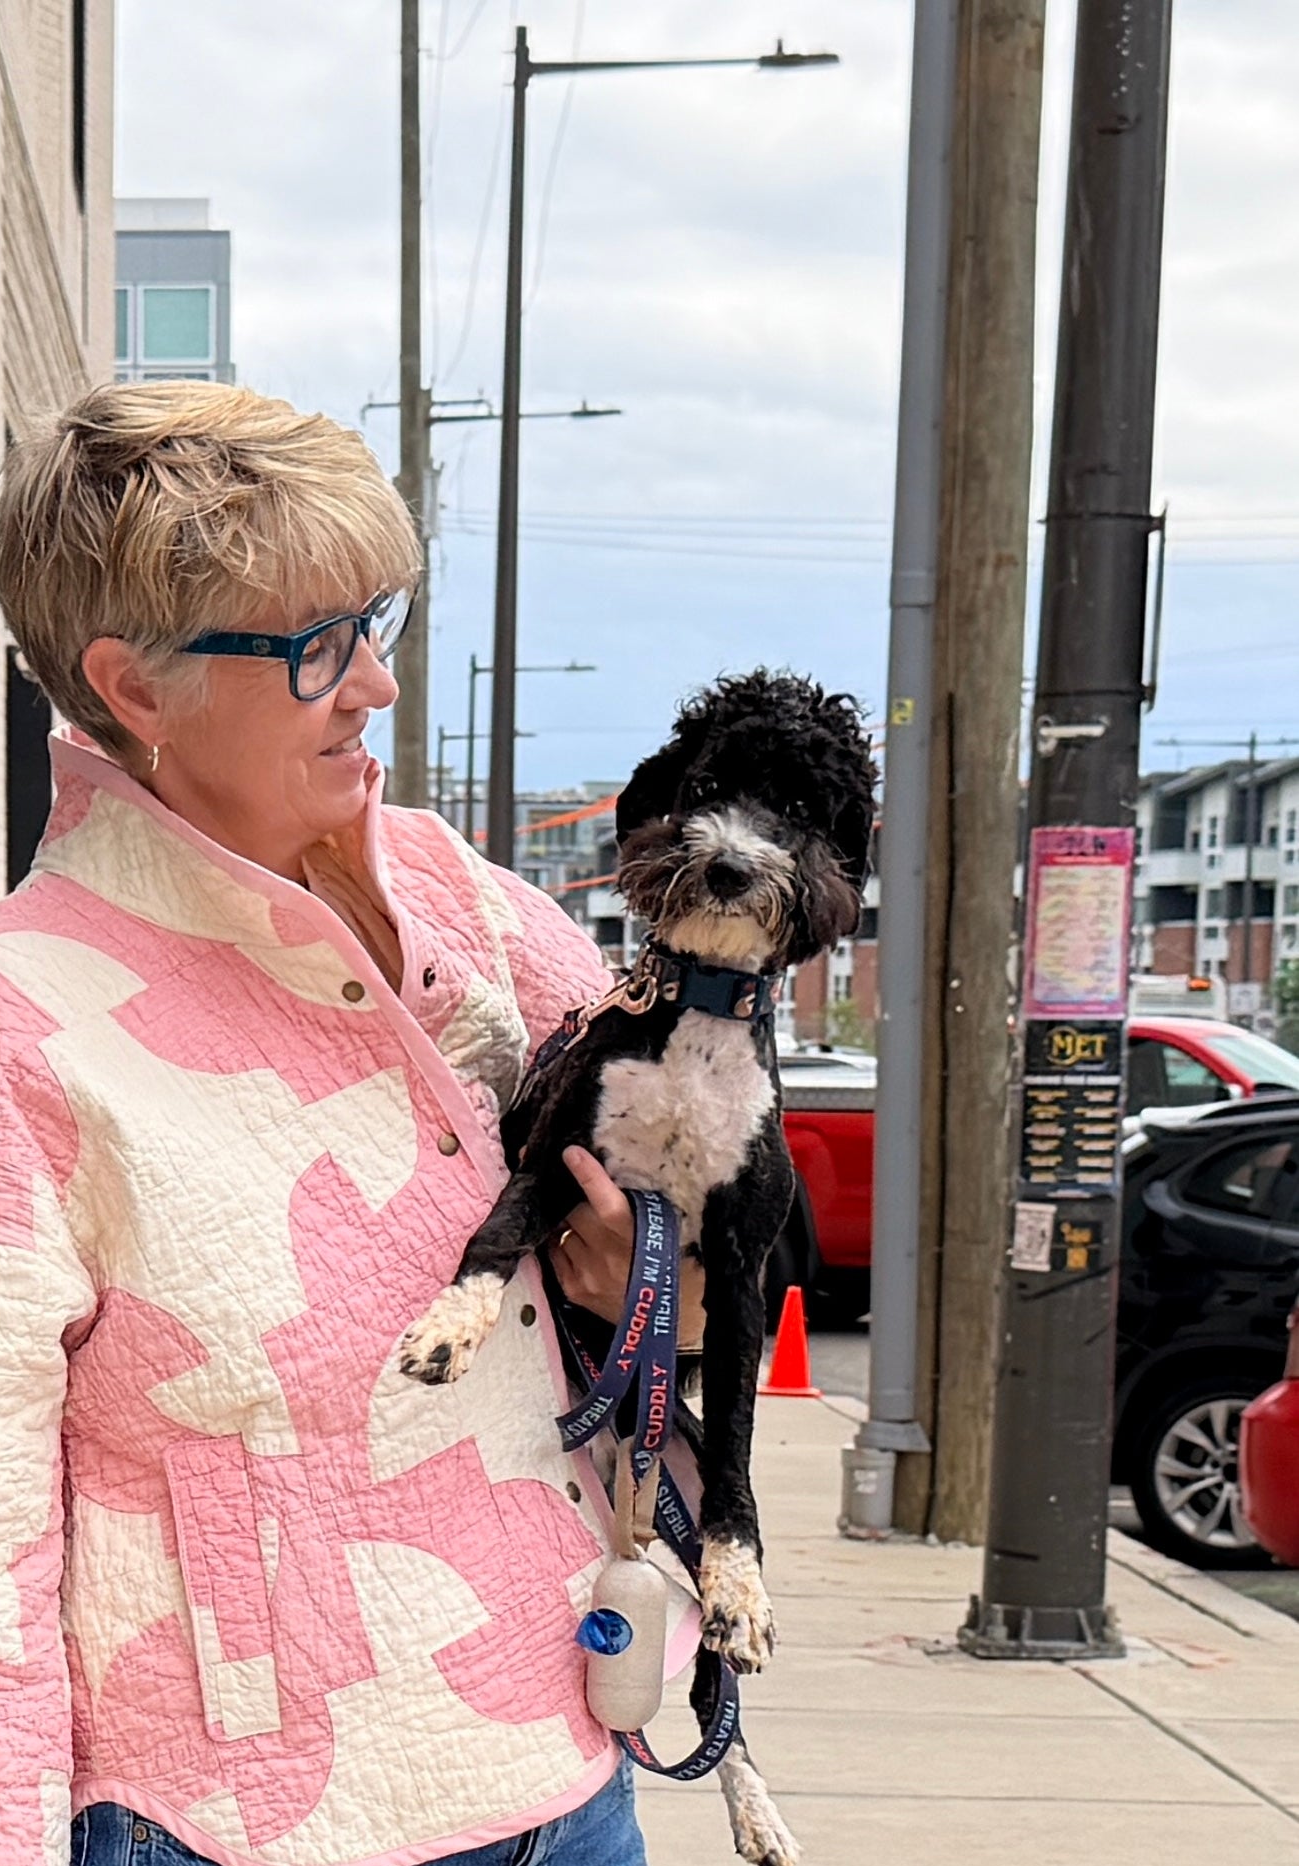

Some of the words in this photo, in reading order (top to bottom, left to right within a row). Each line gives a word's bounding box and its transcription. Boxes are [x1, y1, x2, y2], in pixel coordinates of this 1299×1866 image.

[616, 1286, 656, 1373] CUDDLY
[566, 1396, 614, 1438] TREATS
[643, 1363, 669, 1449] CUDDLY
[658, 1485, 691, 1543] TREATS
[705, 1700, 737, 1758] TREATS
